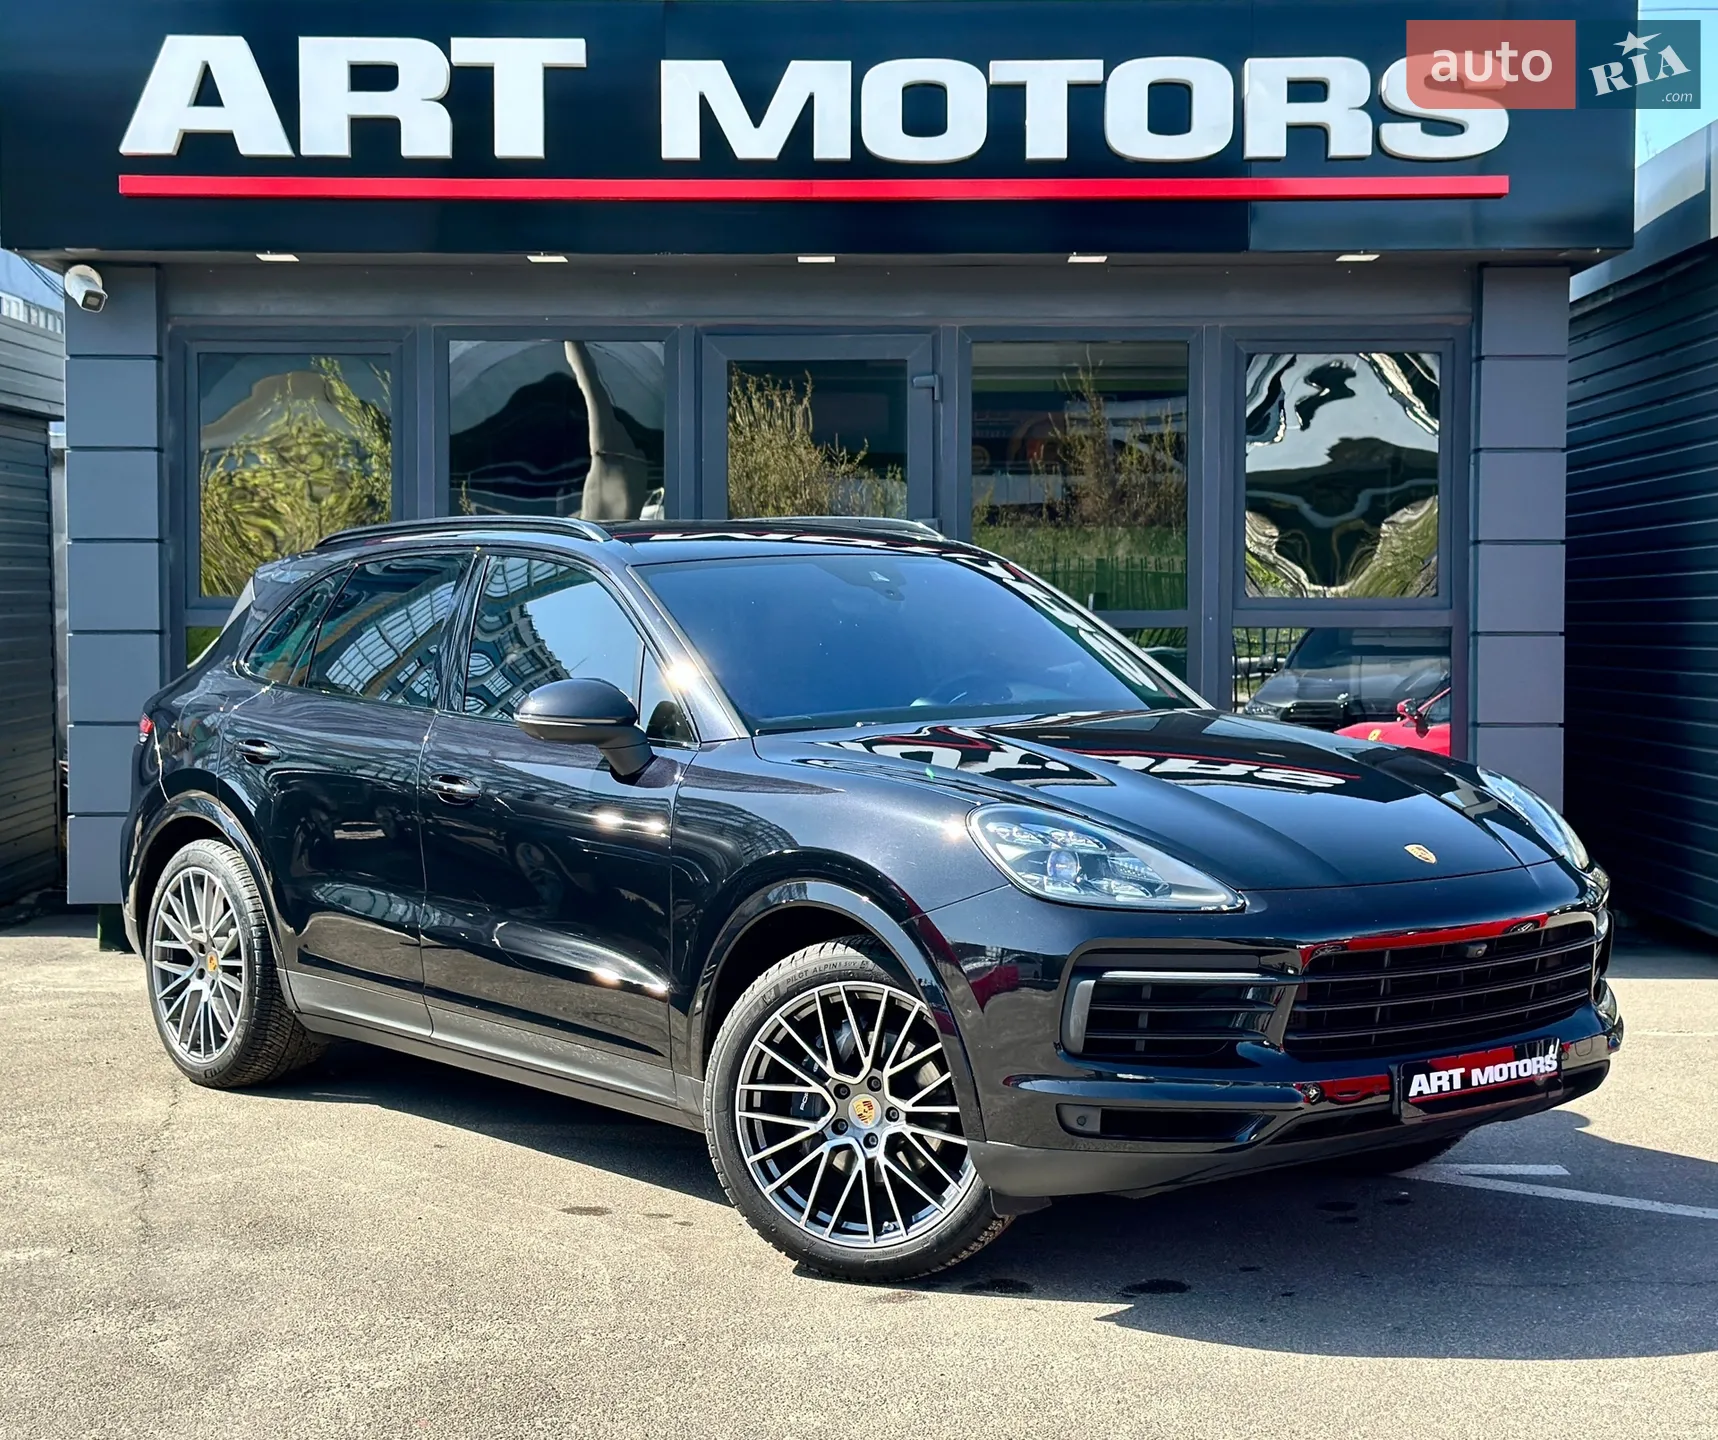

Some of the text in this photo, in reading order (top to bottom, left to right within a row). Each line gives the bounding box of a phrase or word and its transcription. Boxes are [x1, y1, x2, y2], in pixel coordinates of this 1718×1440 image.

[118, 34, 1511, 163] ART MOTORS
[786, 969, 809, 985] PILOT
[1408, 1054, 1558, 1097] ART MOTORS
